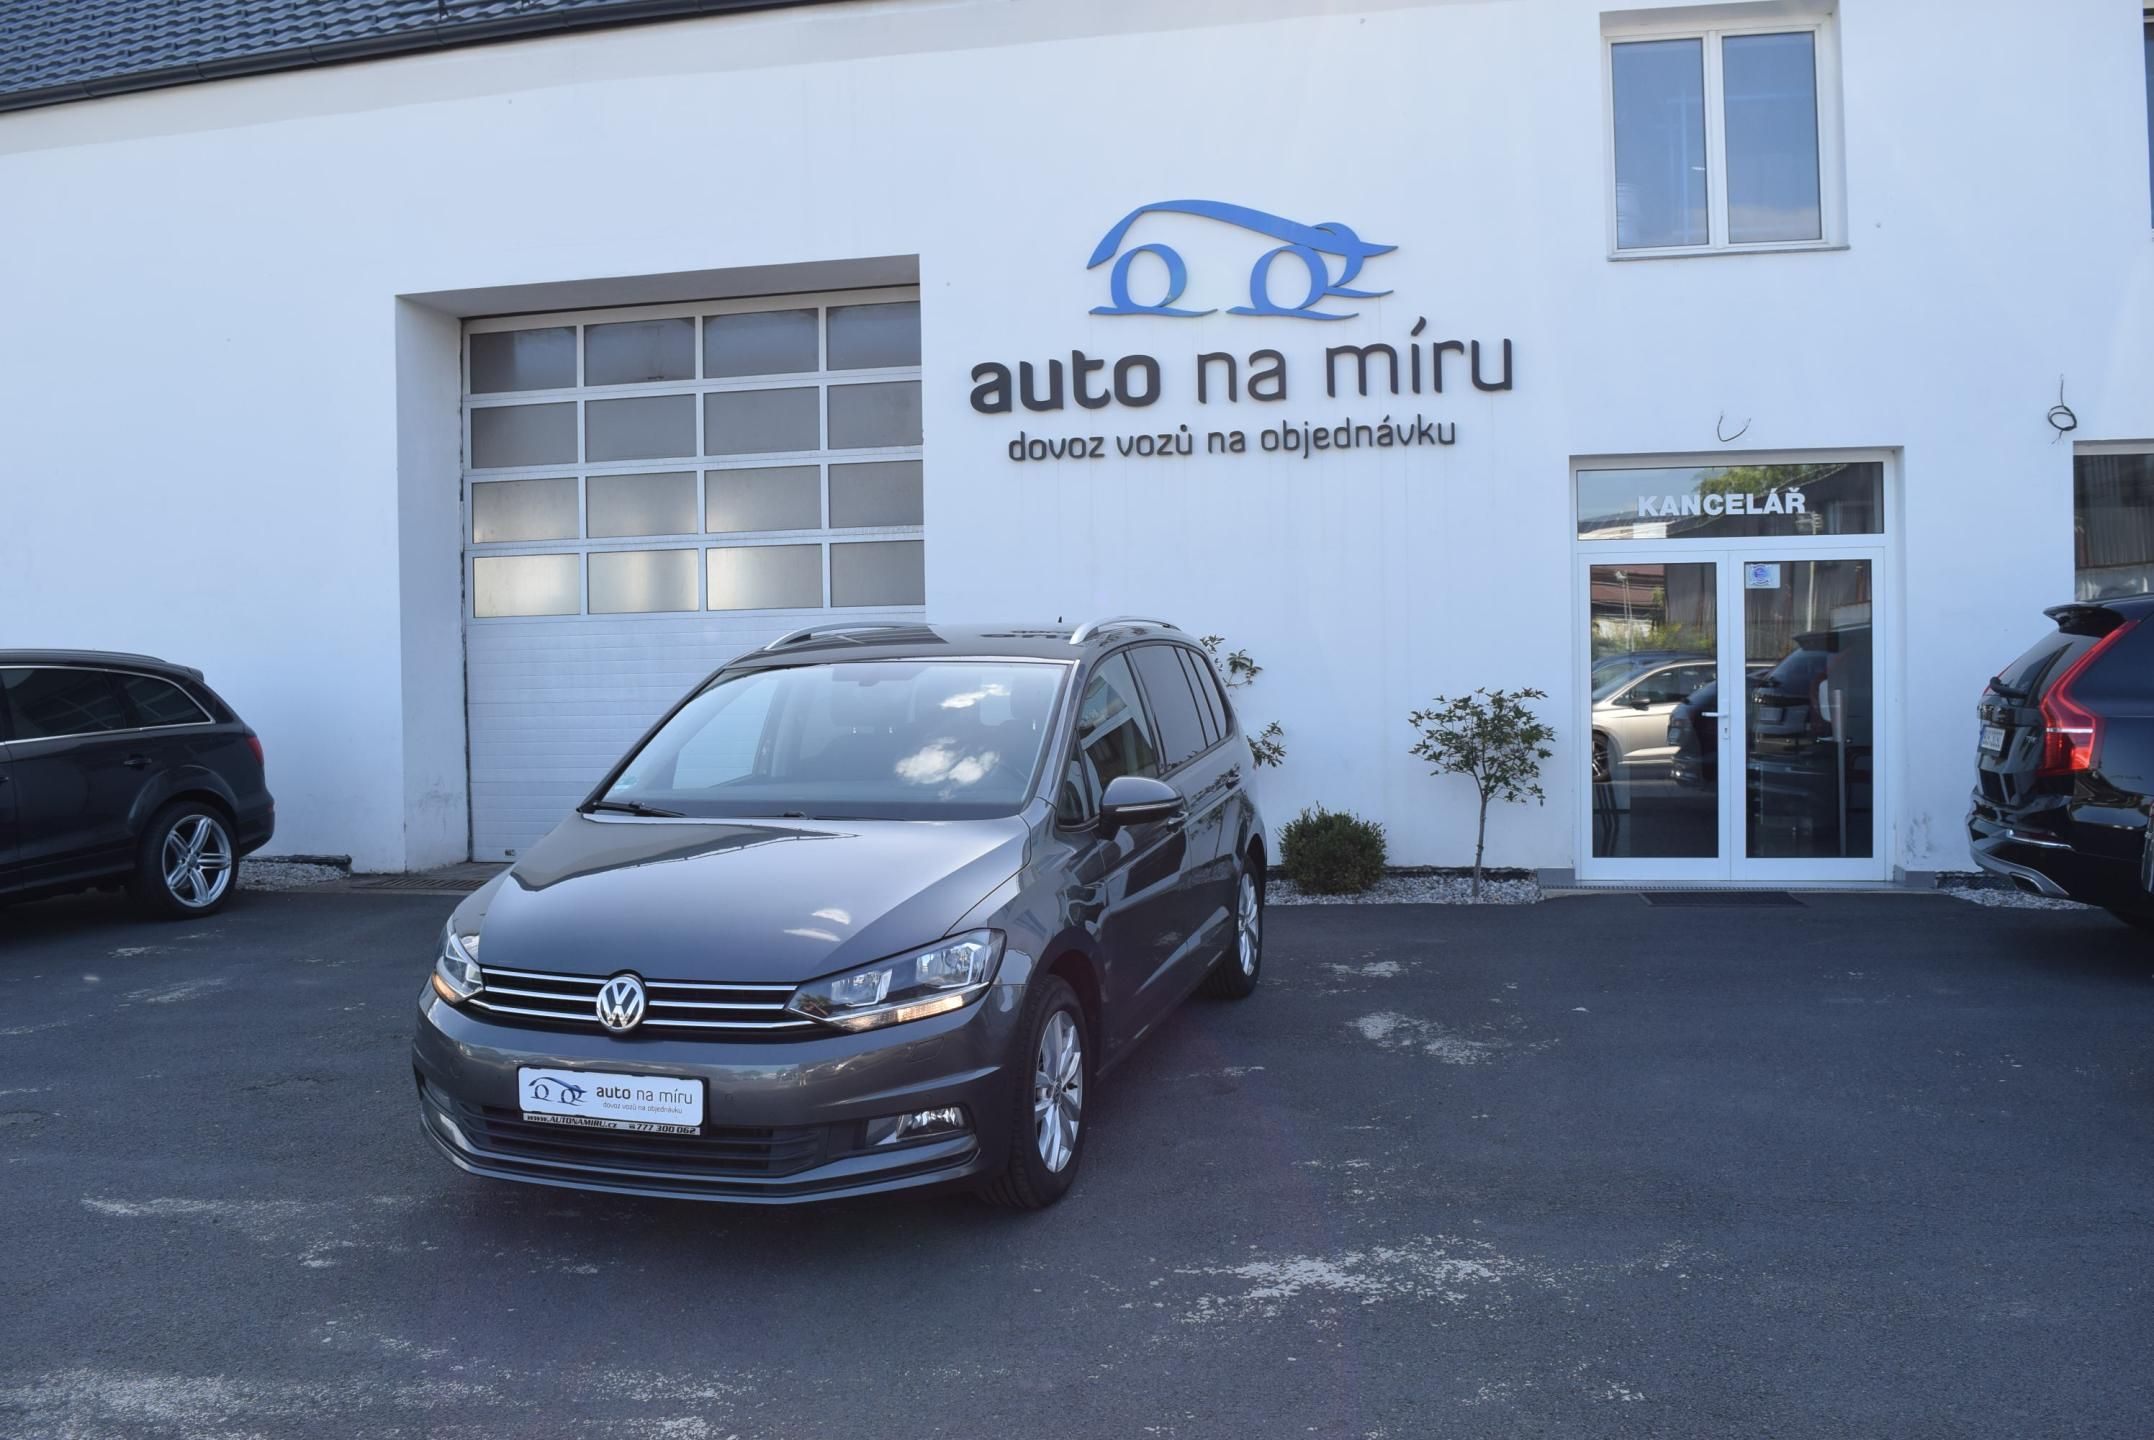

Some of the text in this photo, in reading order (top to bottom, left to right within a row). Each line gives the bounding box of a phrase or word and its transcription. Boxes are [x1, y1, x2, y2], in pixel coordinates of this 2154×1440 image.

[970, 316, 1513, 414] auto na míru
[1008, 413, 1456, 463] dovoz vozů na objednávku
[1638, 487, 1806, 517] KANCELÁŘ
[596, 1086, 693, 1105] auto na míru
[602, 1101, 621, 1110] dovoz
[647, 1104, 683, 1115] objednávku
[636, 1122, 654, 1132] 777
[655, 1125, 675, 1134] 300
[676, 1126, 697, 1136] 062
